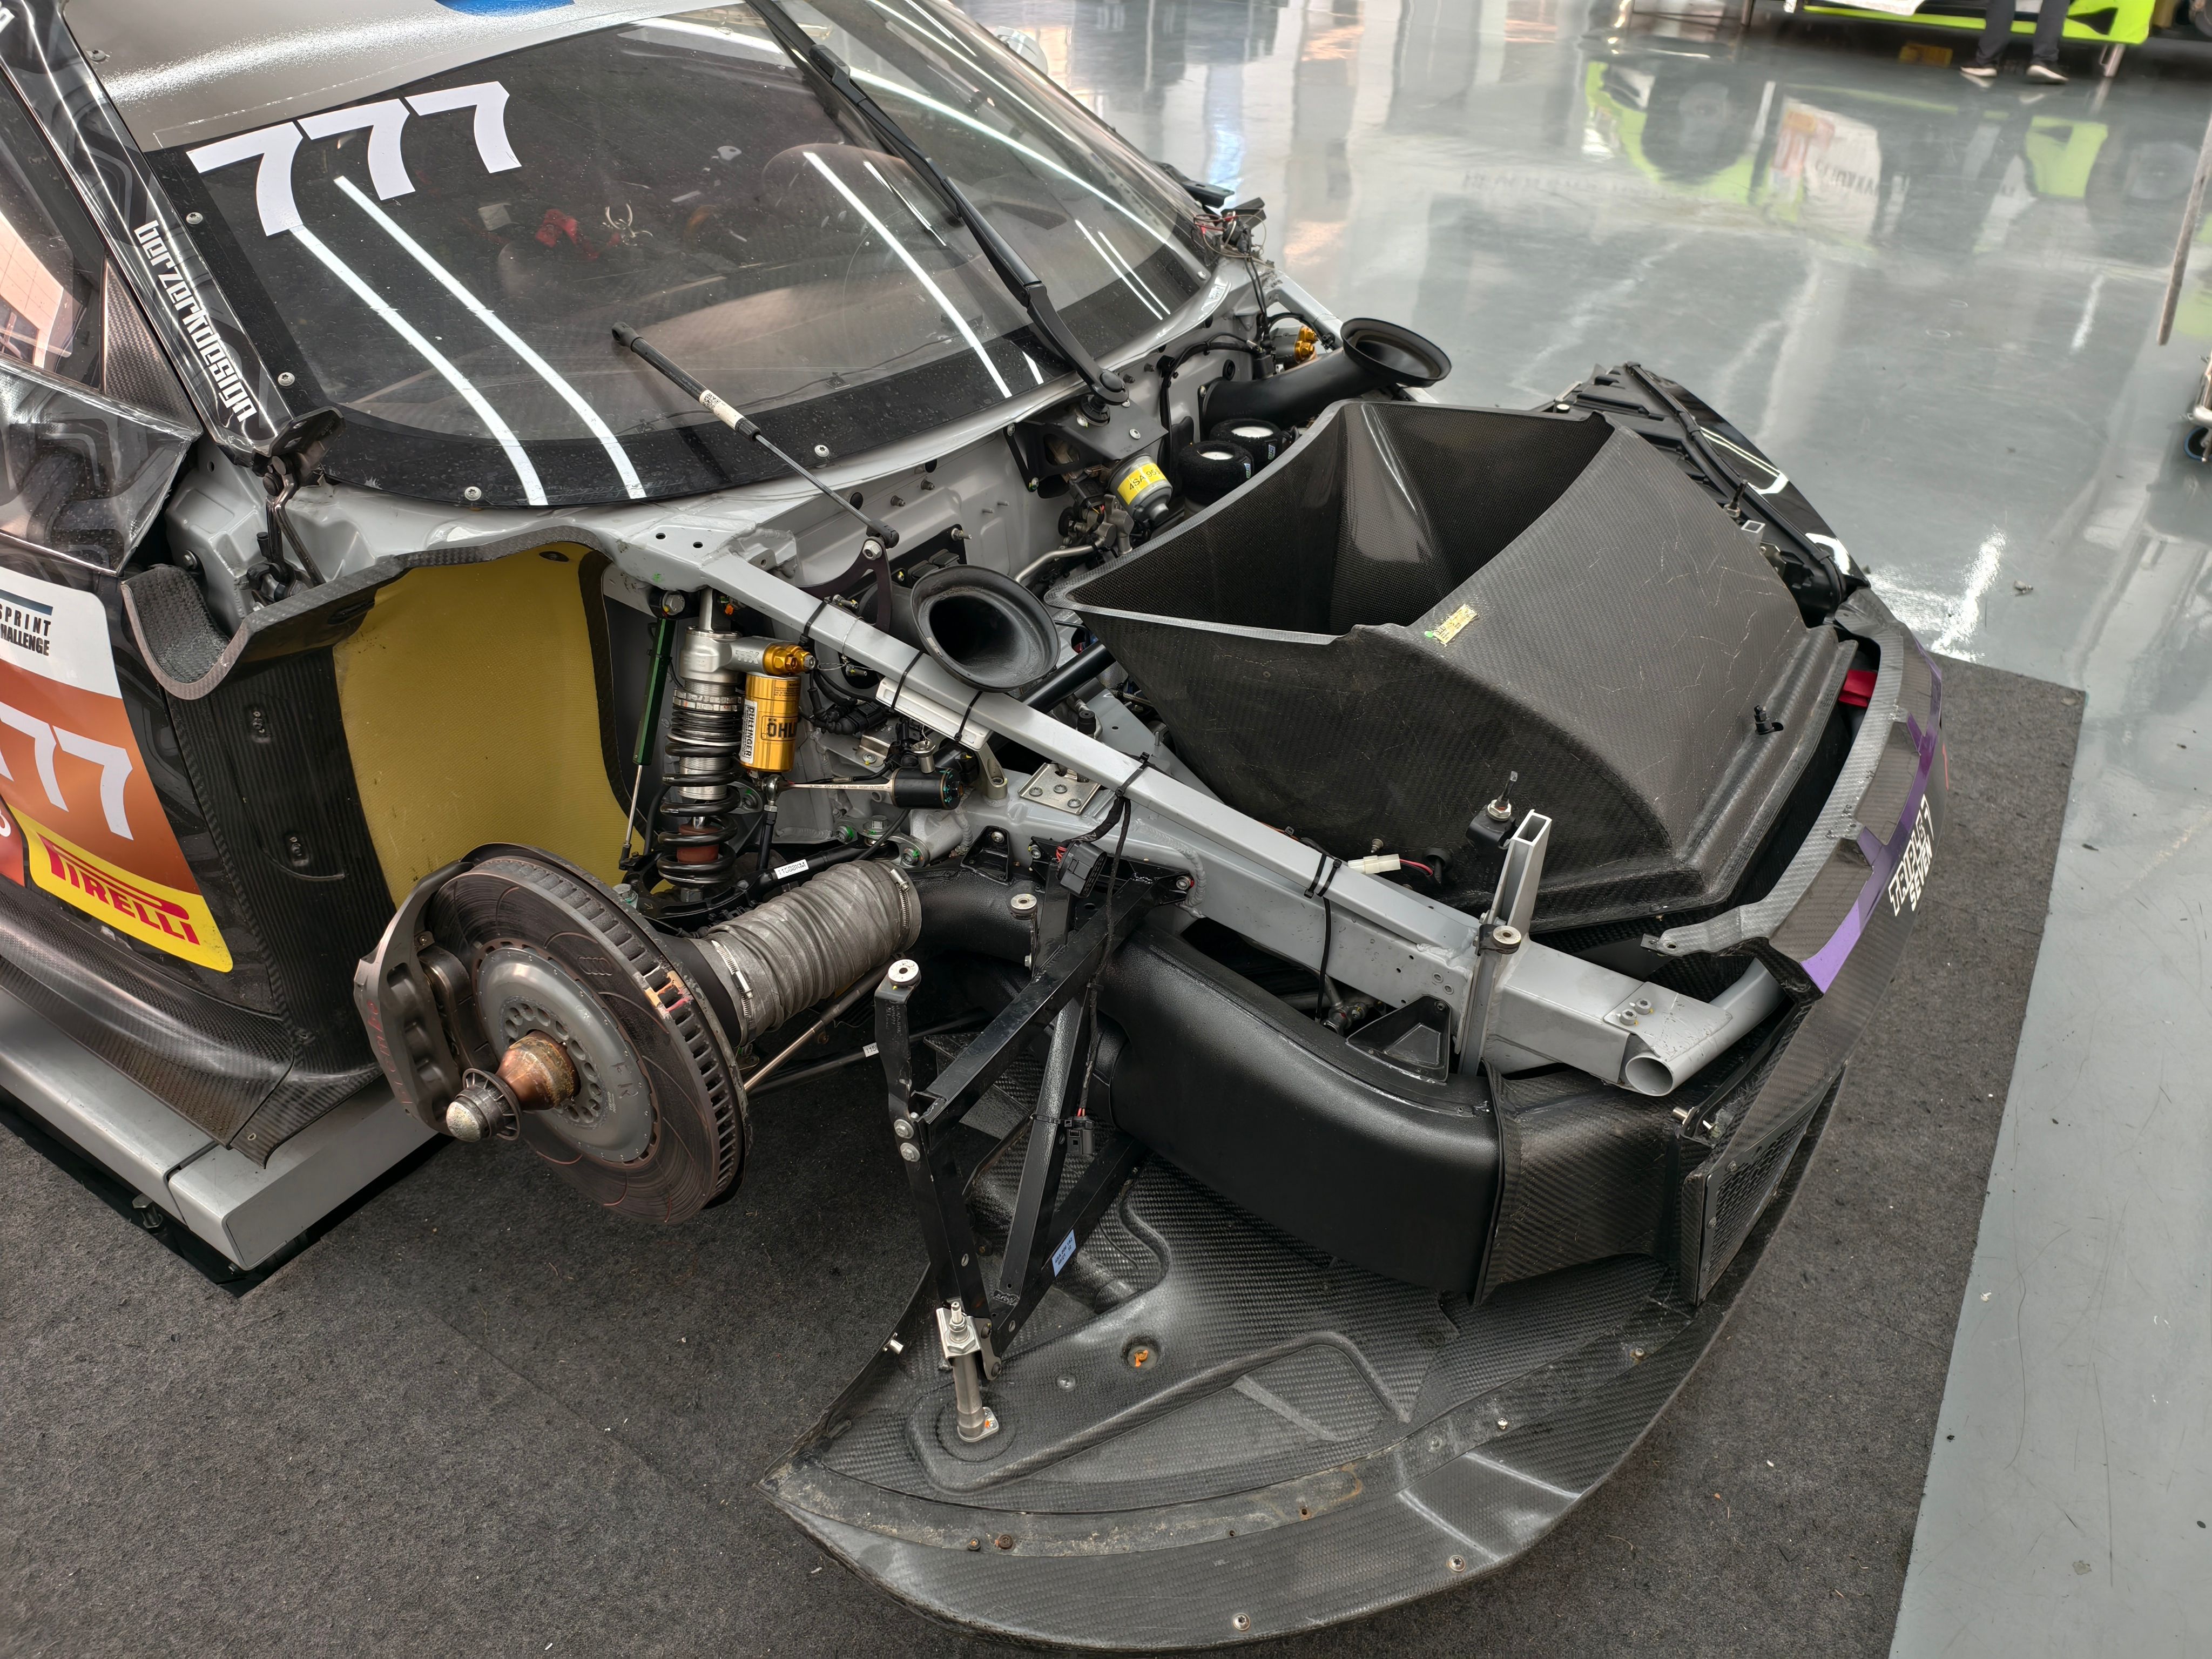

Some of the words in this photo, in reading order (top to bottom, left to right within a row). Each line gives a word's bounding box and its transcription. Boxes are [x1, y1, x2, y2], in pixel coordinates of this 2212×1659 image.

[186, 81, 522, 237] 777
[134, 220, 257, 422] berzerkdesign
[1129, 475, 1146, 490] 4SA
[735, 650, 759, 665] TTX
[0, 702, 134, 841] 77
[36, 832, 200, 946] PIRELLI
[1888, 810, 1926, 916] TRIPLE
[1909, 834, 1932, 912] SEVEN
